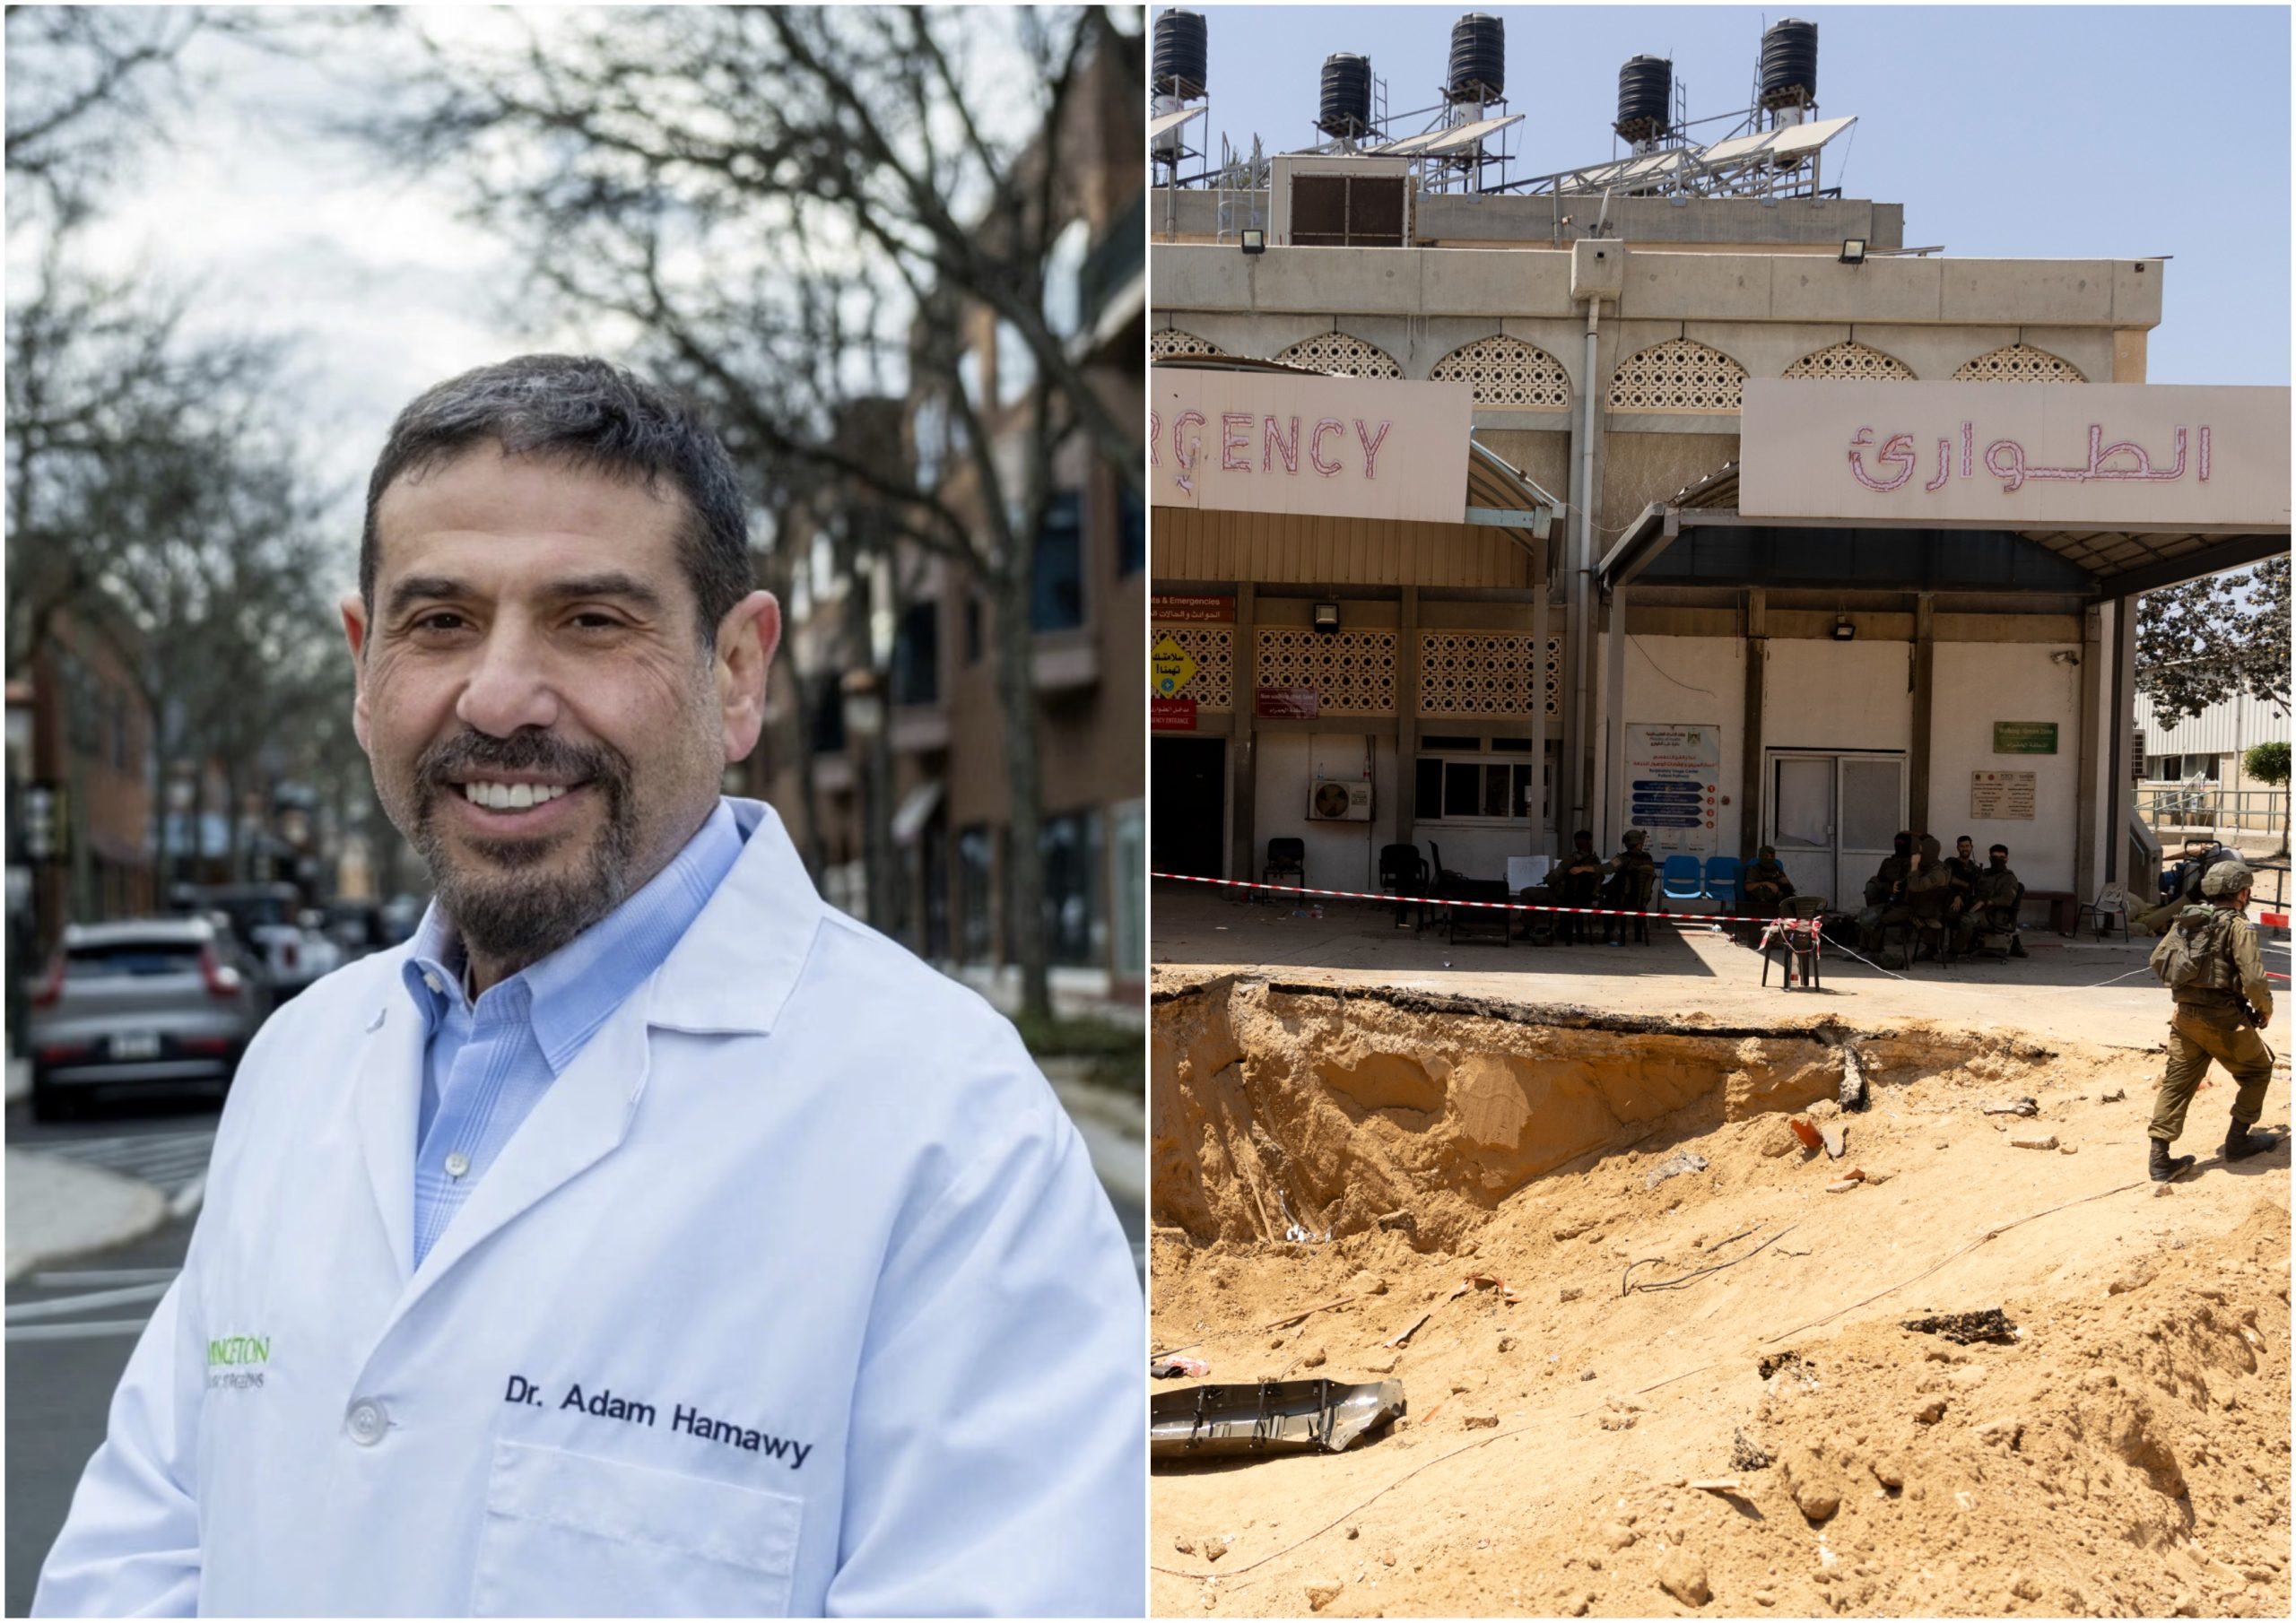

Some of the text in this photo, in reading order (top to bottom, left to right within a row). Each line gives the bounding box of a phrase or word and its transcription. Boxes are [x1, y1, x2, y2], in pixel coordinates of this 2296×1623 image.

[1848, 421, 2212, 493] الطوارئ
[1170, 597, 1220, 606] Emergencies
[1152, 653, 1184, 661] سلامتك
[1166, 716, 1189, 725] ENTRANCE
[504, 1375, 813, 1470] Dr. Adam Hamawy
